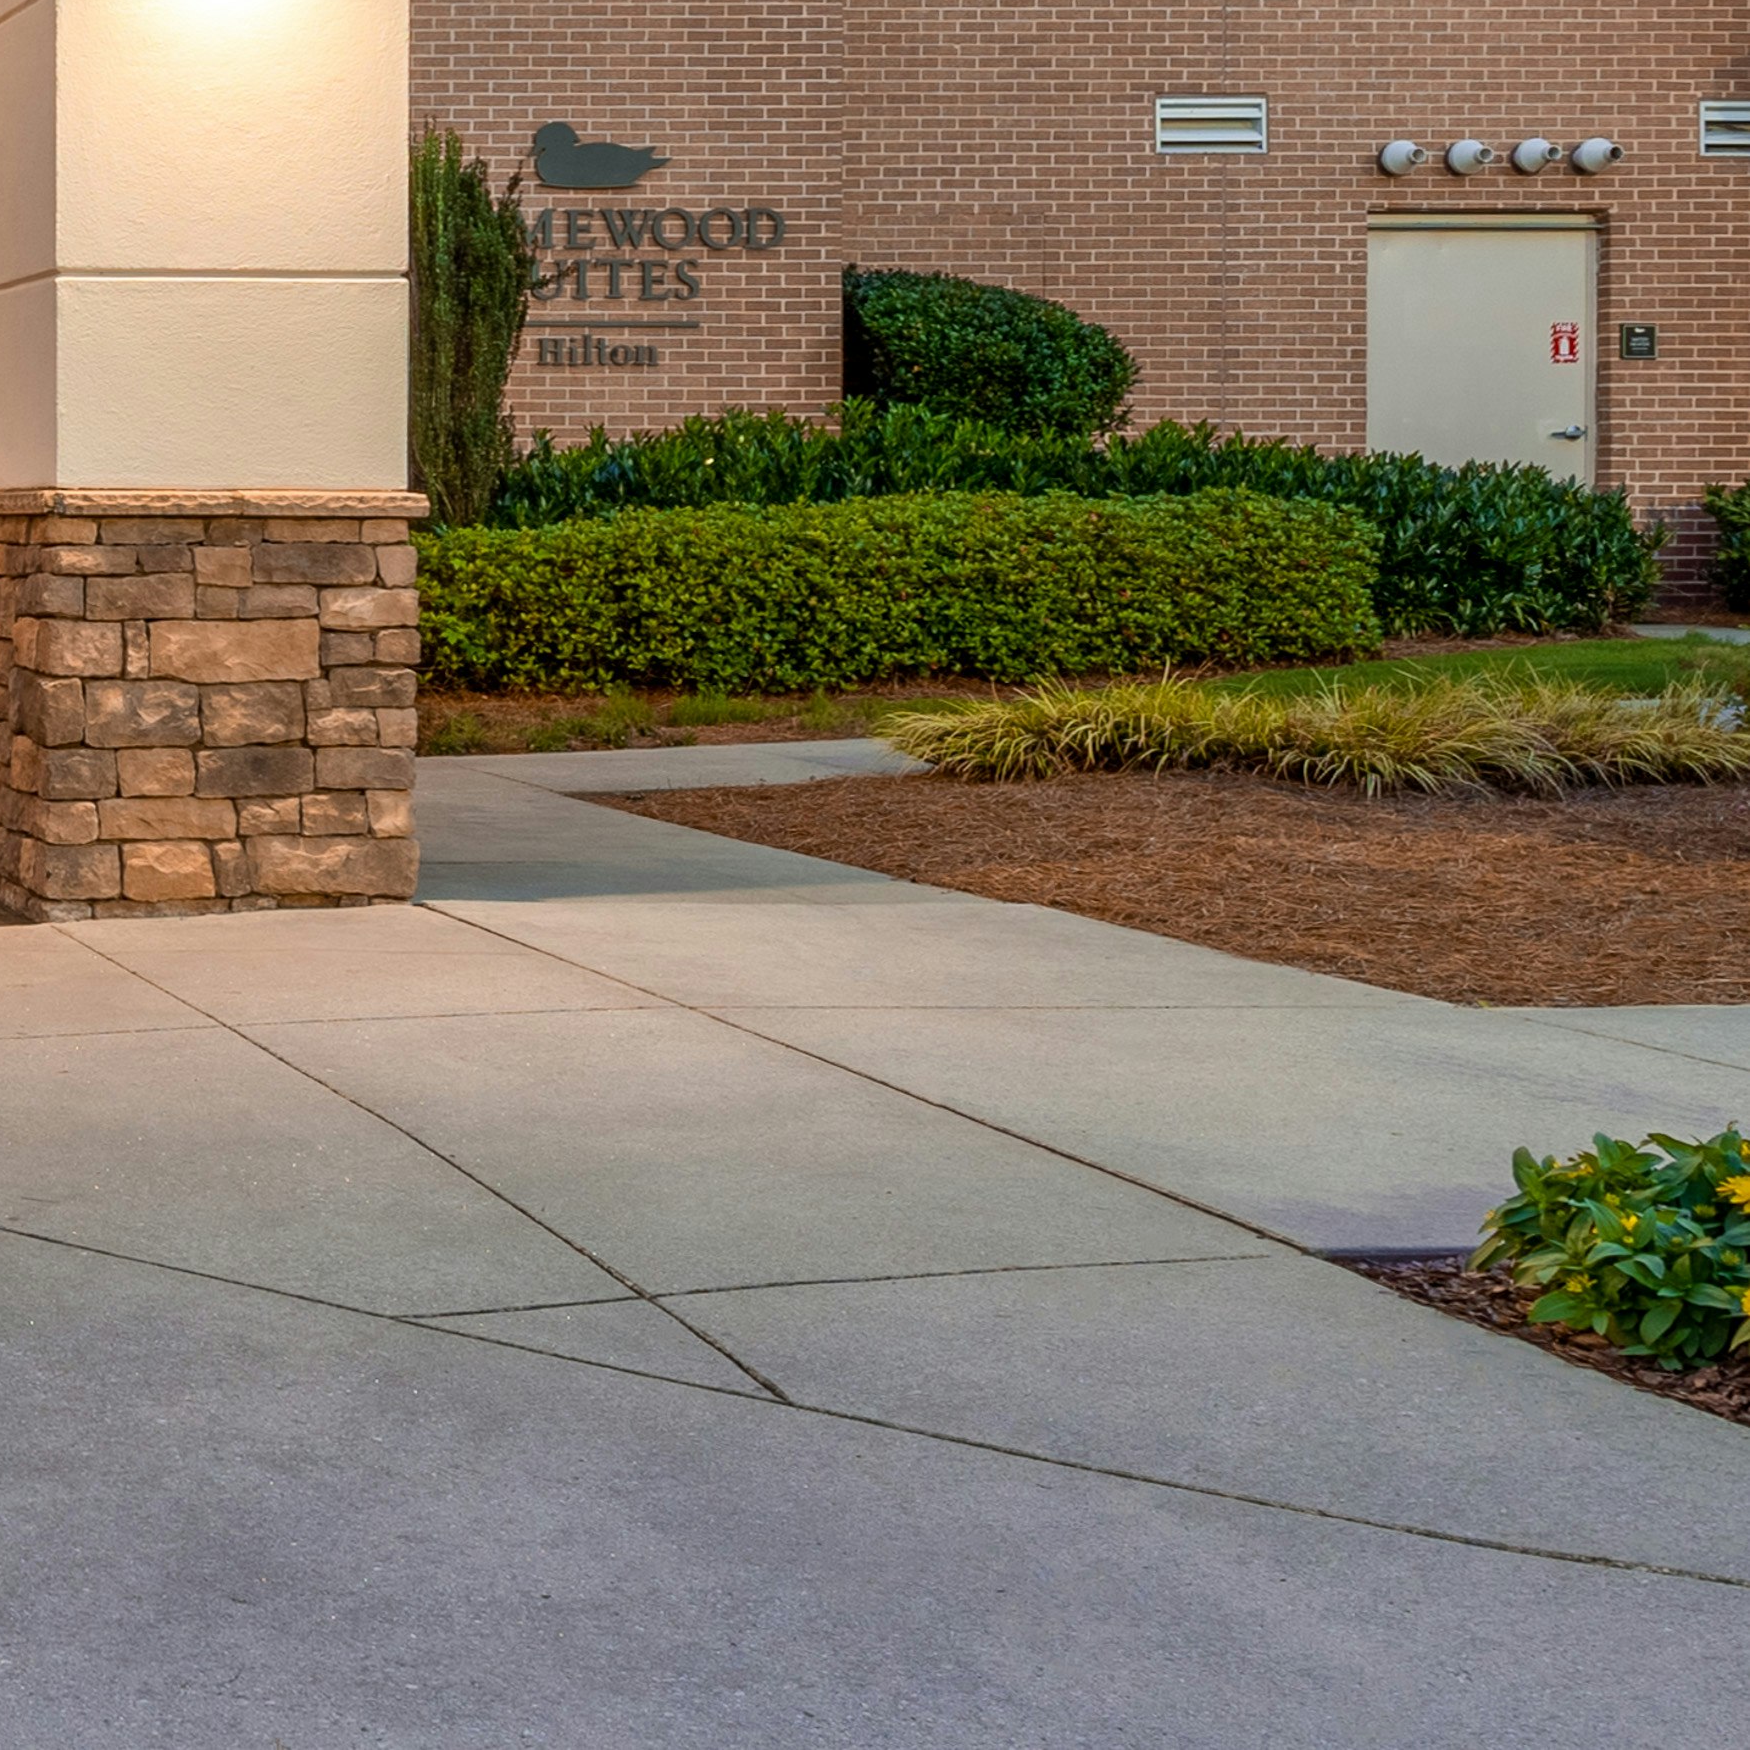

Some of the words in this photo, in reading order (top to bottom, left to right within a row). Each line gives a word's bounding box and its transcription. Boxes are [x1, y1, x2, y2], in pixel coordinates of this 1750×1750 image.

[516, 207, 787, 250] MEWOOD
[531, 258, 701, 300] UITES
[537, 334, 659, 366] Hilton
